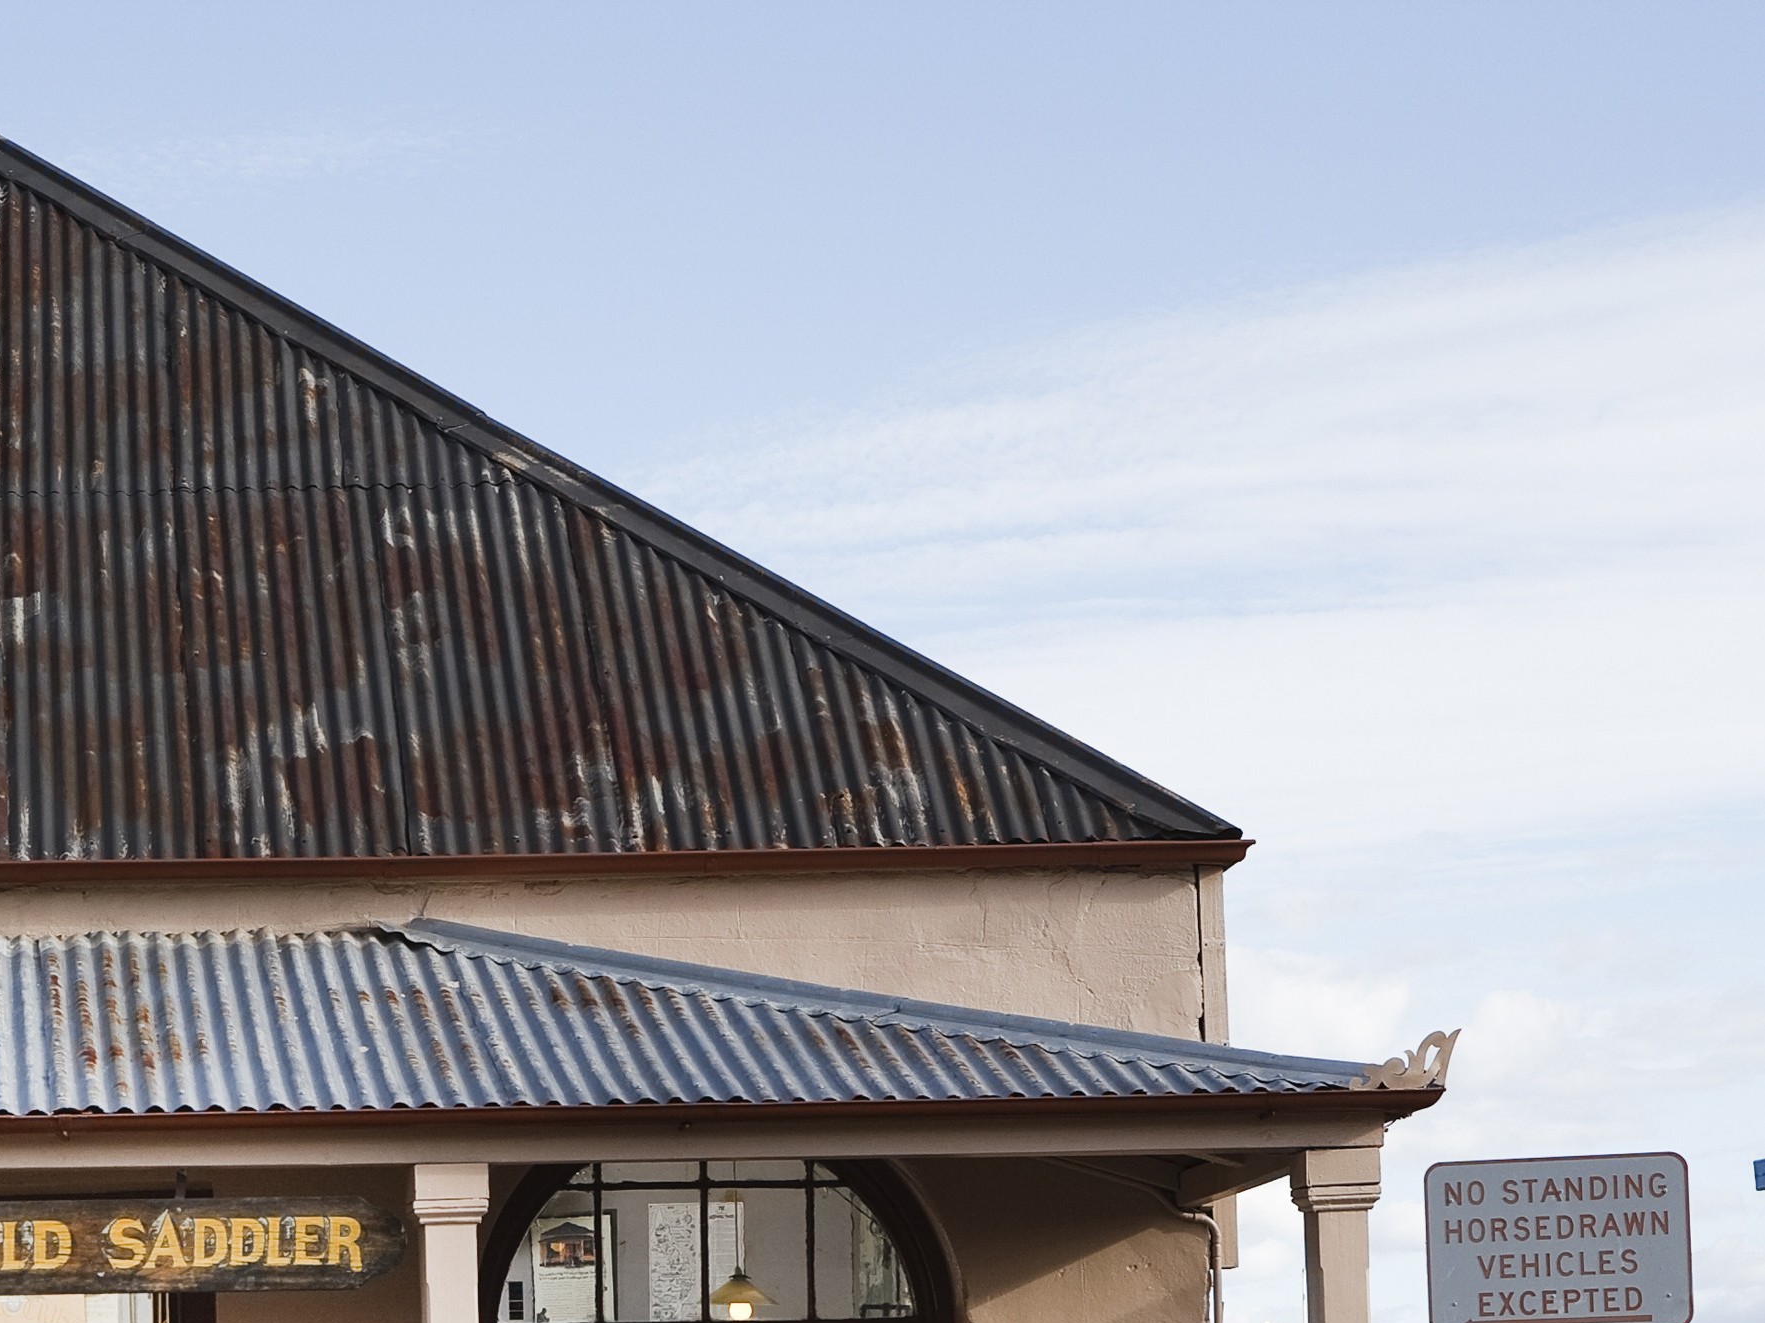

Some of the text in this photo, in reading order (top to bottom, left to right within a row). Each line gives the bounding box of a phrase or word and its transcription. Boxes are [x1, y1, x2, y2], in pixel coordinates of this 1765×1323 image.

[1443, 1172, 1667, 1207] NO STANDING
[102, 1211, 363, 1273] SADDLER
[1443, 1210, 1669, 1244] HORSEDRAWN
[1476, 1248, 1639, 1279] VEHICLES
[1477, 1286, 1644, 1317] EXCEPTED
